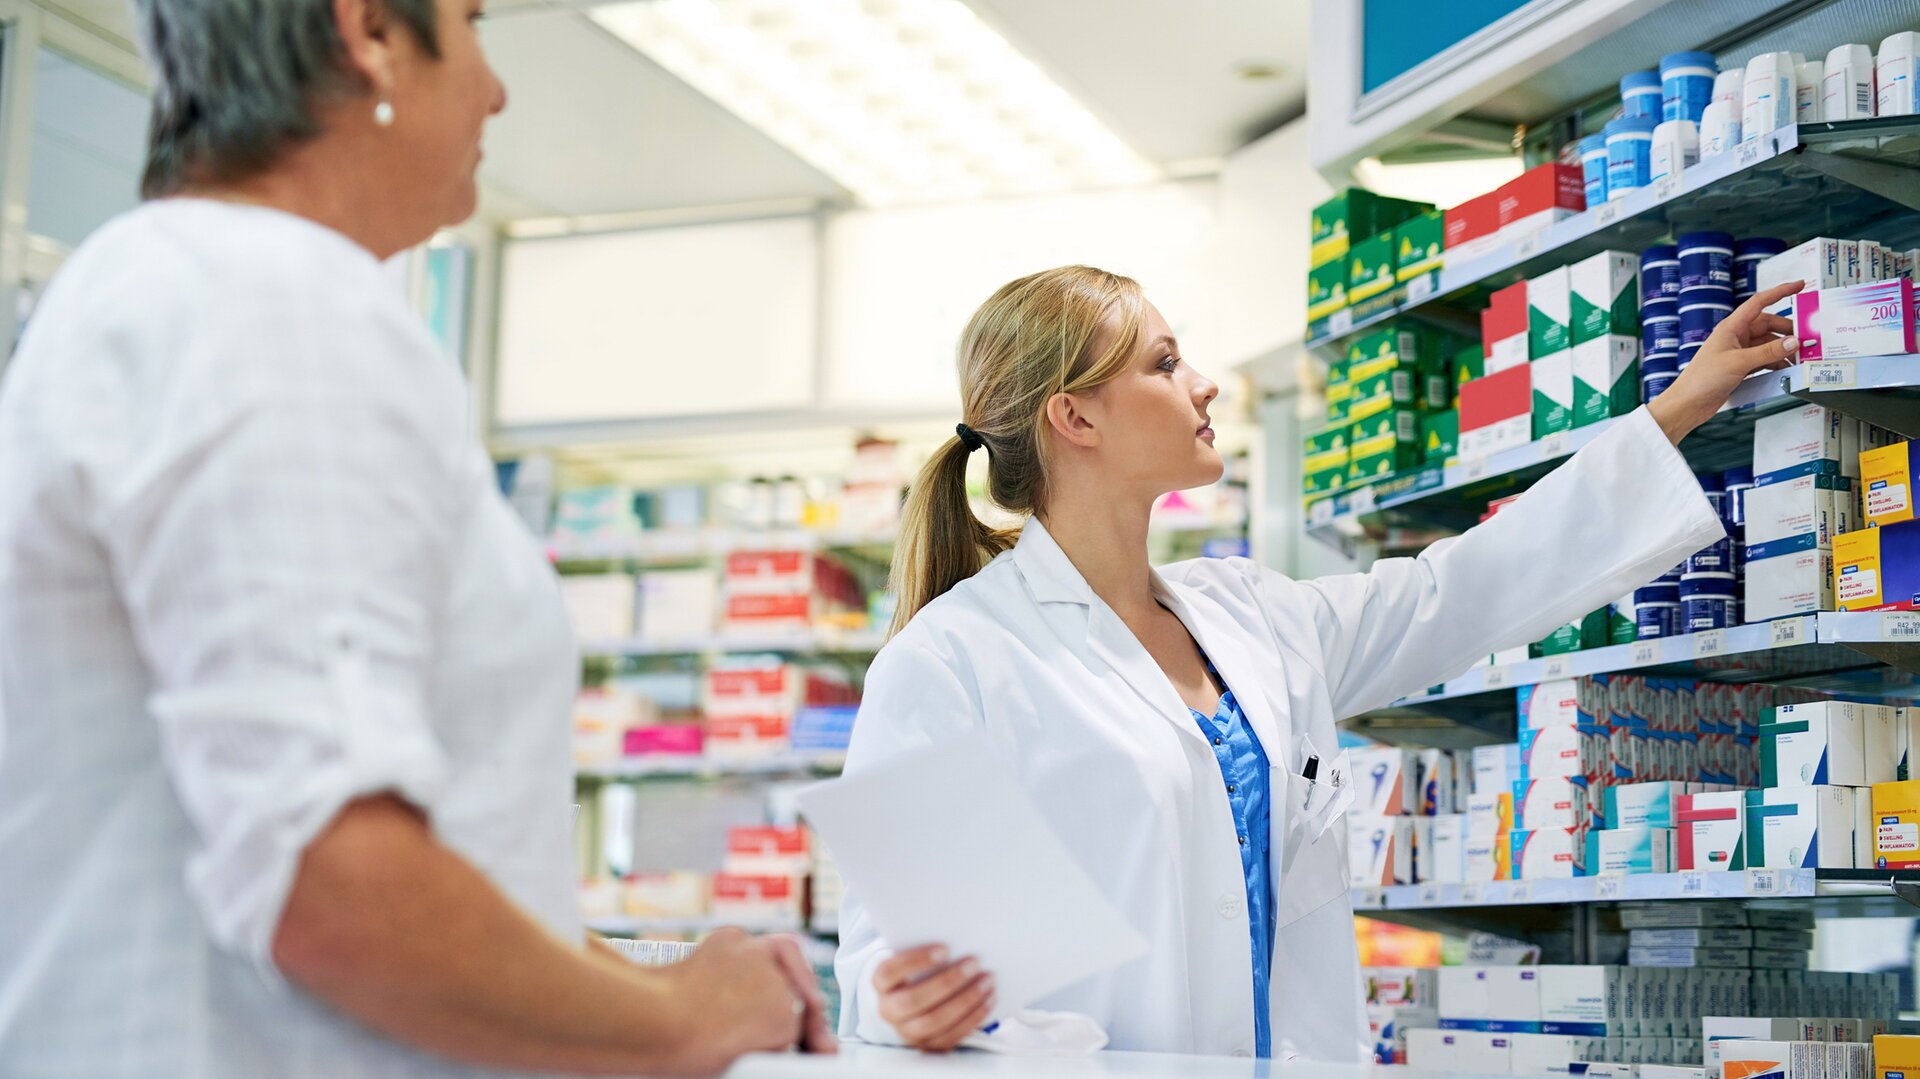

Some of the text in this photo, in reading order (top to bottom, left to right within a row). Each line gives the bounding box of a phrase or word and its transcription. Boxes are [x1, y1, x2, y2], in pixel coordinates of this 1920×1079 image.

[1870, 303, 1898, 321] 200
[1835, 326, 1847, 334] 200
[1874, 503, 1904, 513] INFLAMMATION
[1844, 589, 1874, 598] INFLAMMATION
